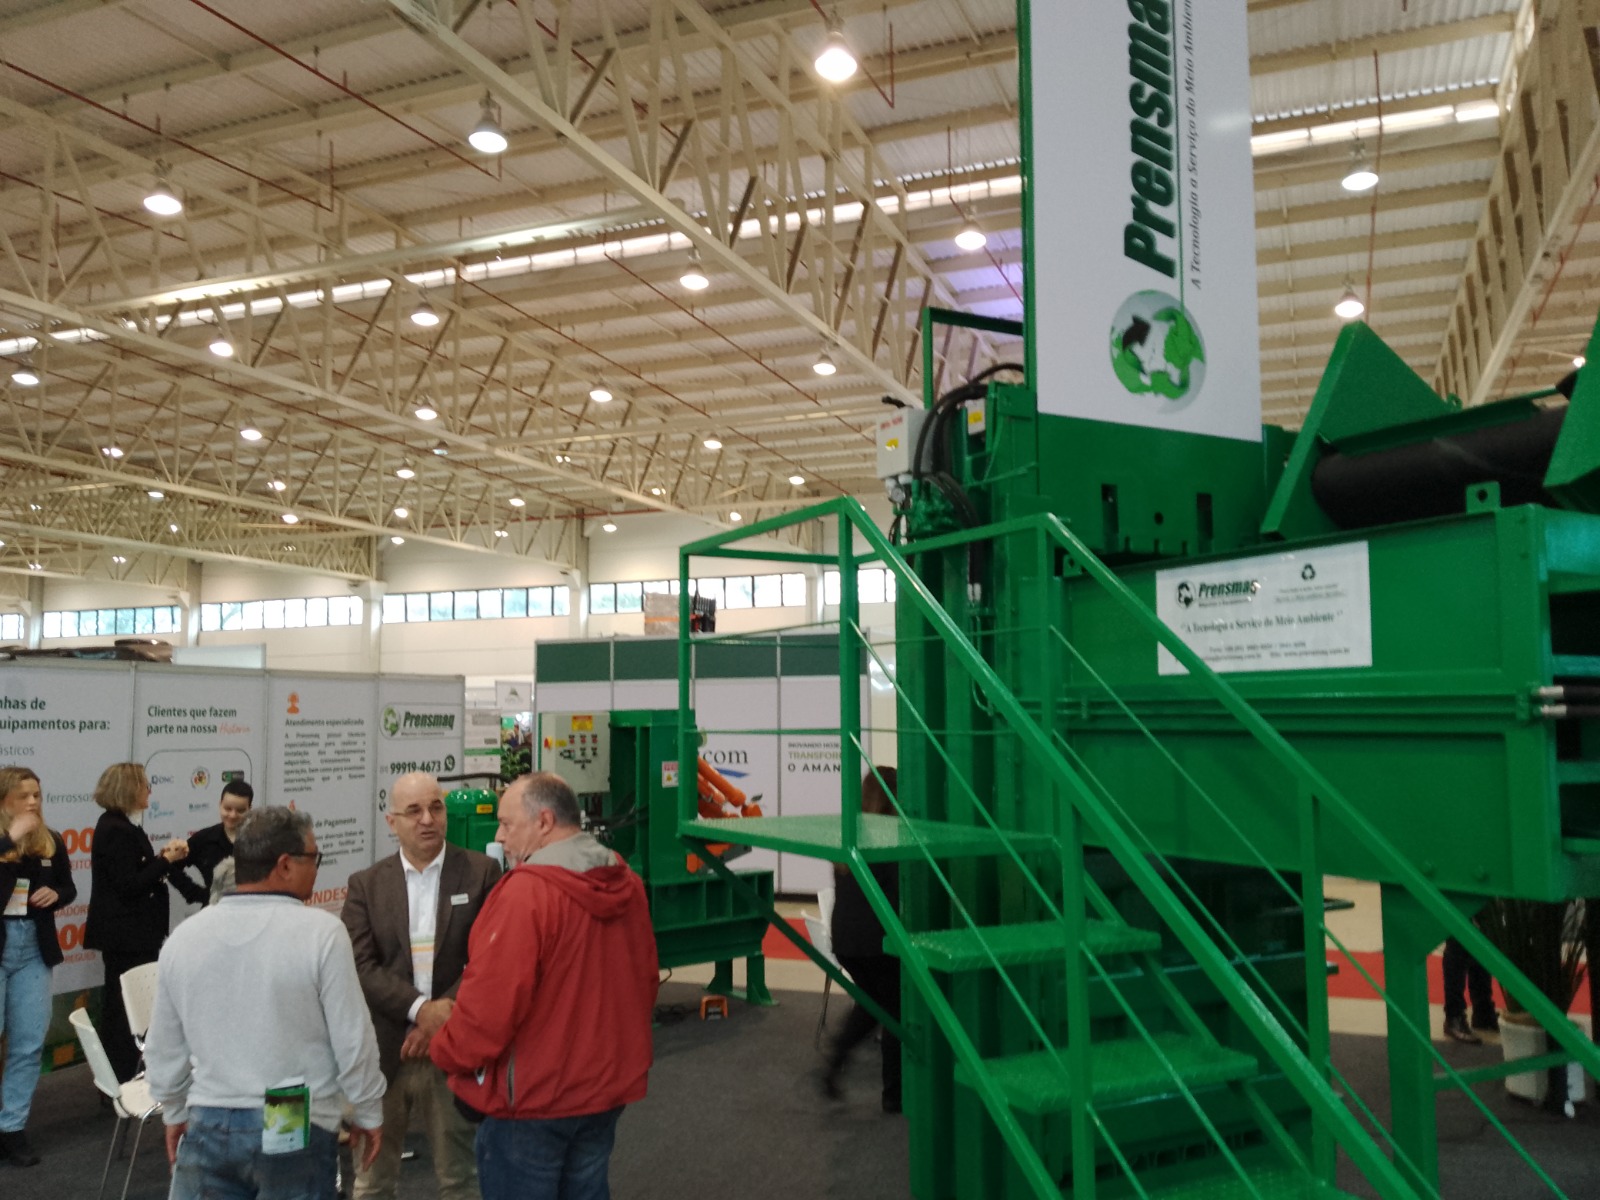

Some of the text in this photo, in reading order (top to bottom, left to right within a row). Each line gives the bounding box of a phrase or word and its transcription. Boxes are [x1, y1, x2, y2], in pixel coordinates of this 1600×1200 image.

[1184, 58, 1195, 96] Meio
[1185, 98, 1197, 118] do
[1187, 120, 1200, 175] Serviço
[1188, 190, 1202, 273] Tecnologia
[30, 696, 46, 711] de
[147, 704, 237, 721] Clientes que fazem
[403, 711, 455, 731] Prensmaq
[79, 719, 111, 734] para:
[146, 723, 174, 737] parte
[176, 724, 189, 734] na
[190, 724, 217, 734] nossa
[390, 759, 442, 775] 99919-4673
[787, 763, 797, 773] O
